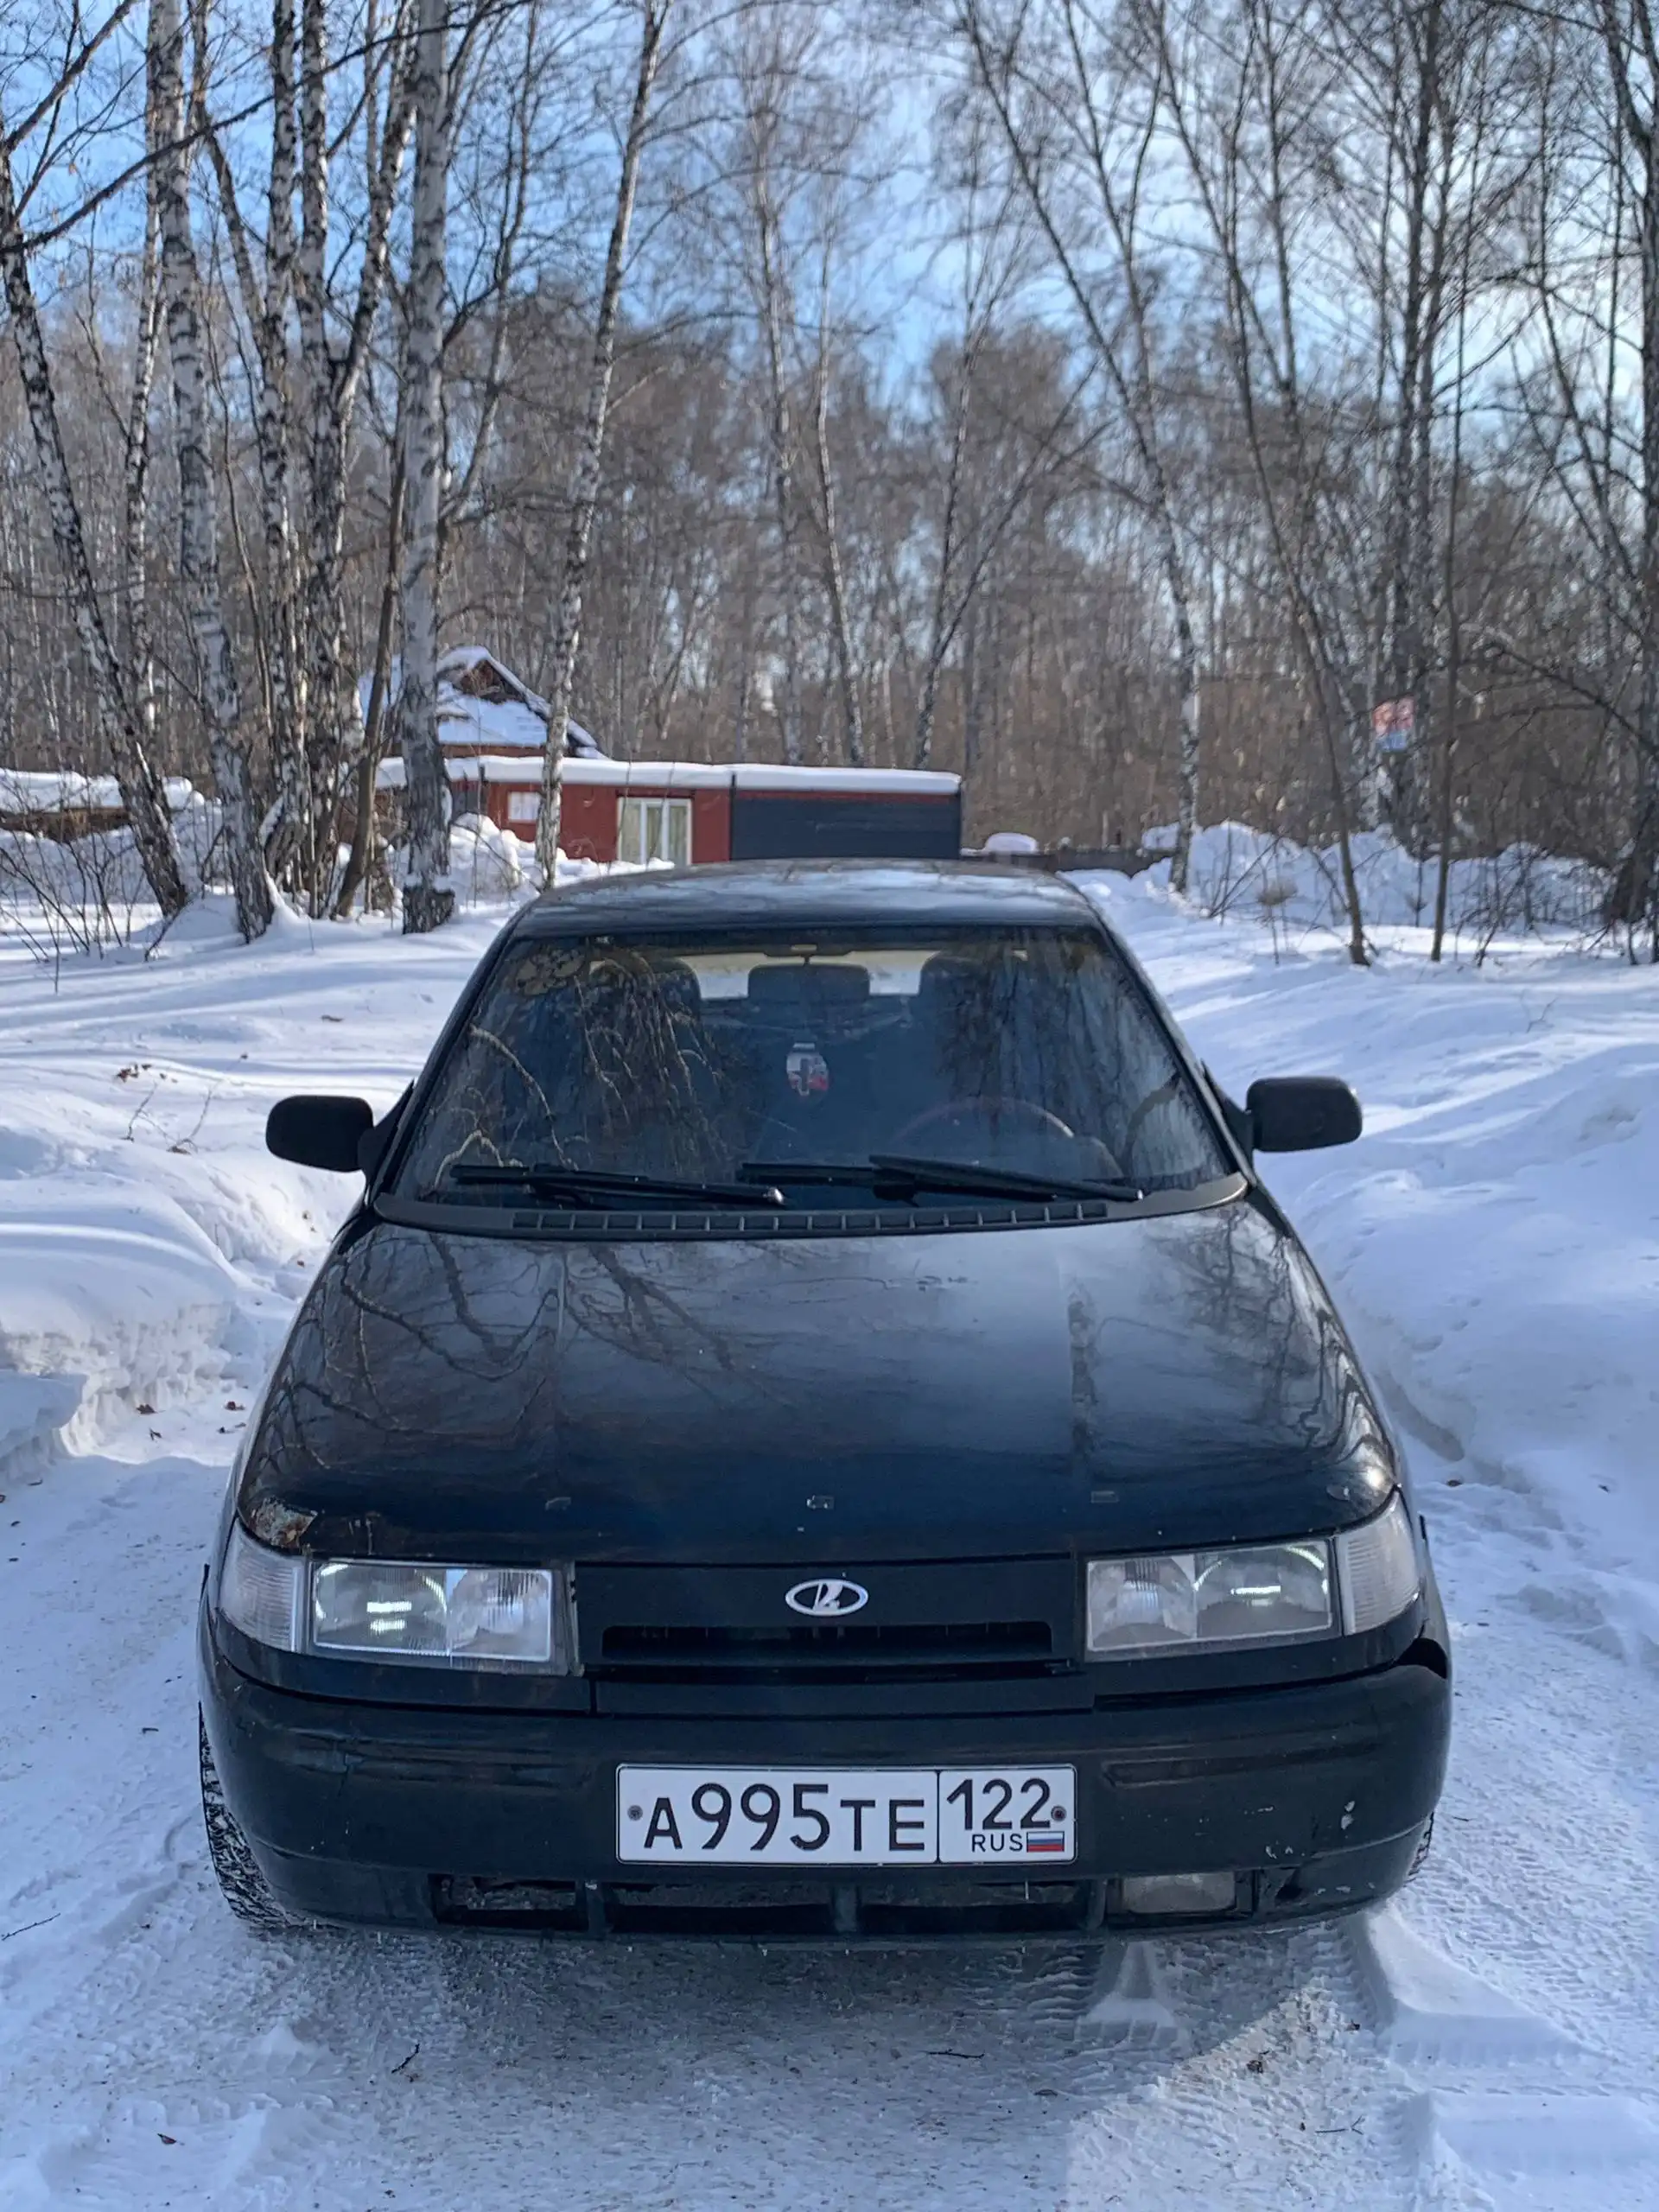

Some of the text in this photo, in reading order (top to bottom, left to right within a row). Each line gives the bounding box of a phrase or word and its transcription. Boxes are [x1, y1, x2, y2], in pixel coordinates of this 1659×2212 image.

[643, 1778, 1052, 1852] A995TE 122
[971, 1834, 1023, 1853] RUS
